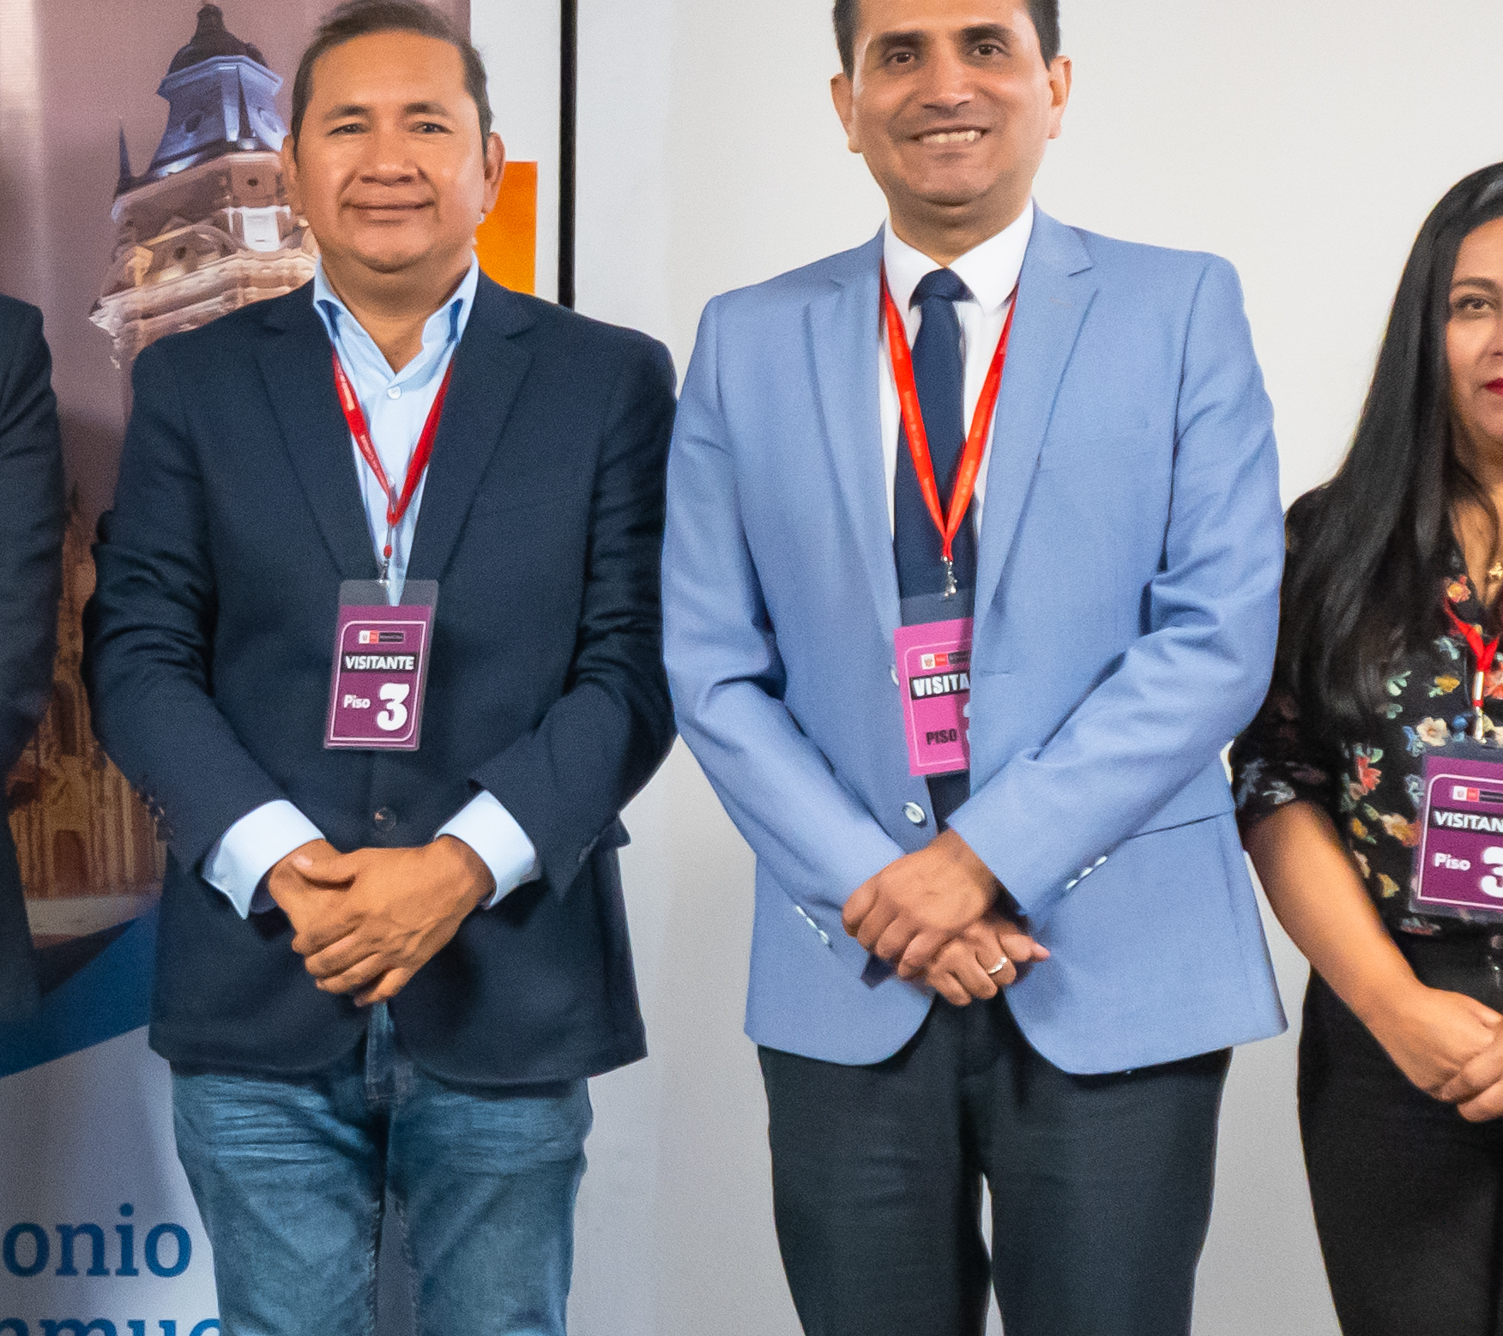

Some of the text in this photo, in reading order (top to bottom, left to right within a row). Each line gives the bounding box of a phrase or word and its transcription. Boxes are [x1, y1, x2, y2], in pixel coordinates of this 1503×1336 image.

[345, 655, 415, 671] VISITANTE
[343, 682, 410, 731] Piso 3
[926, 728, 958, 746] PISO
[1433, 852, 1471, 871] Piso
